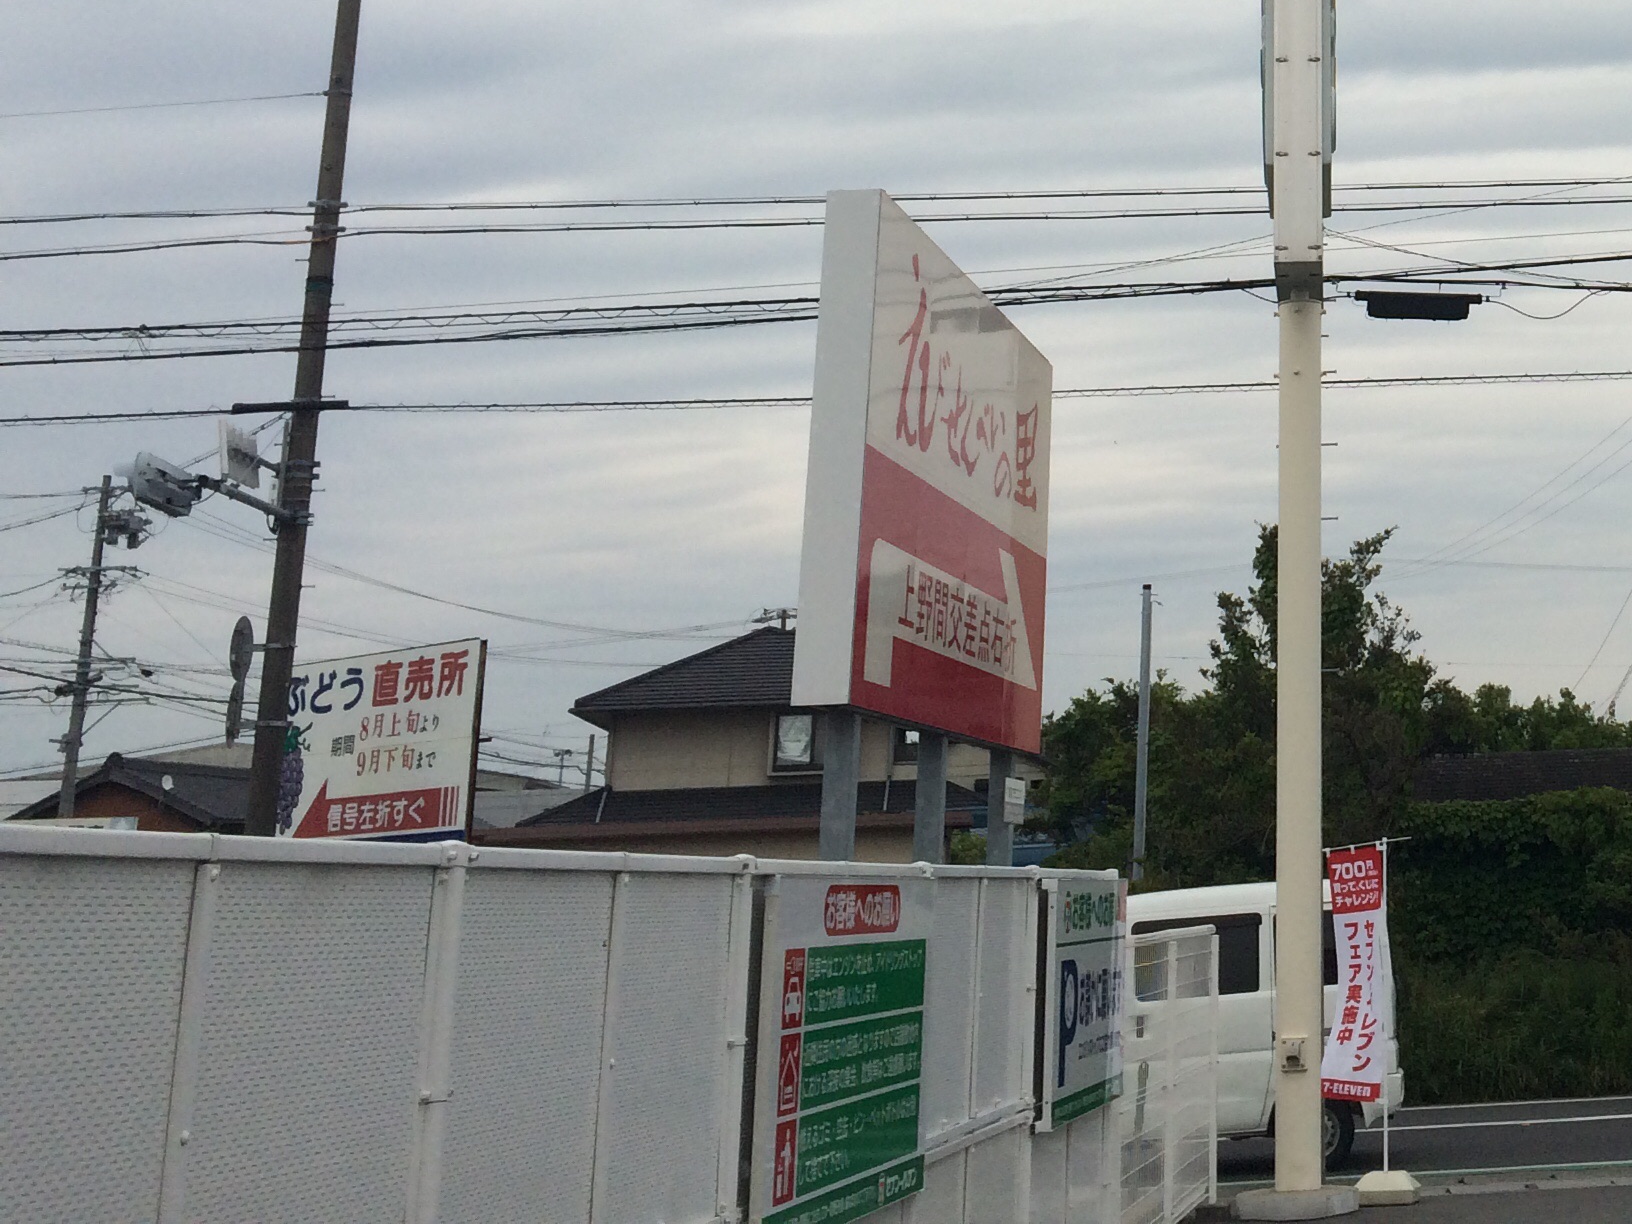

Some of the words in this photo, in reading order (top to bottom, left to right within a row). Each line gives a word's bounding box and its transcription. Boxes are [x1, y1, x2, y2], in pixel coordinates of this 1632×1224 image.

[898, 563, 1018, 676] 上野間交差点右折
[287, 667, 364, 716] ぶどう
[372, 649, 469, 707] 直売所
[330, 734, 356, 757] 期間
[359, 710, 440, 742] 8月上旬より
[356, 745, 437, 776] 9月下旬まで
[327, 796, 425, 833] 信号左折すぐ
[825, 890, 899, 931] お客様へのお願い
[1336, 922, 1363, 1046] フェア実施中
